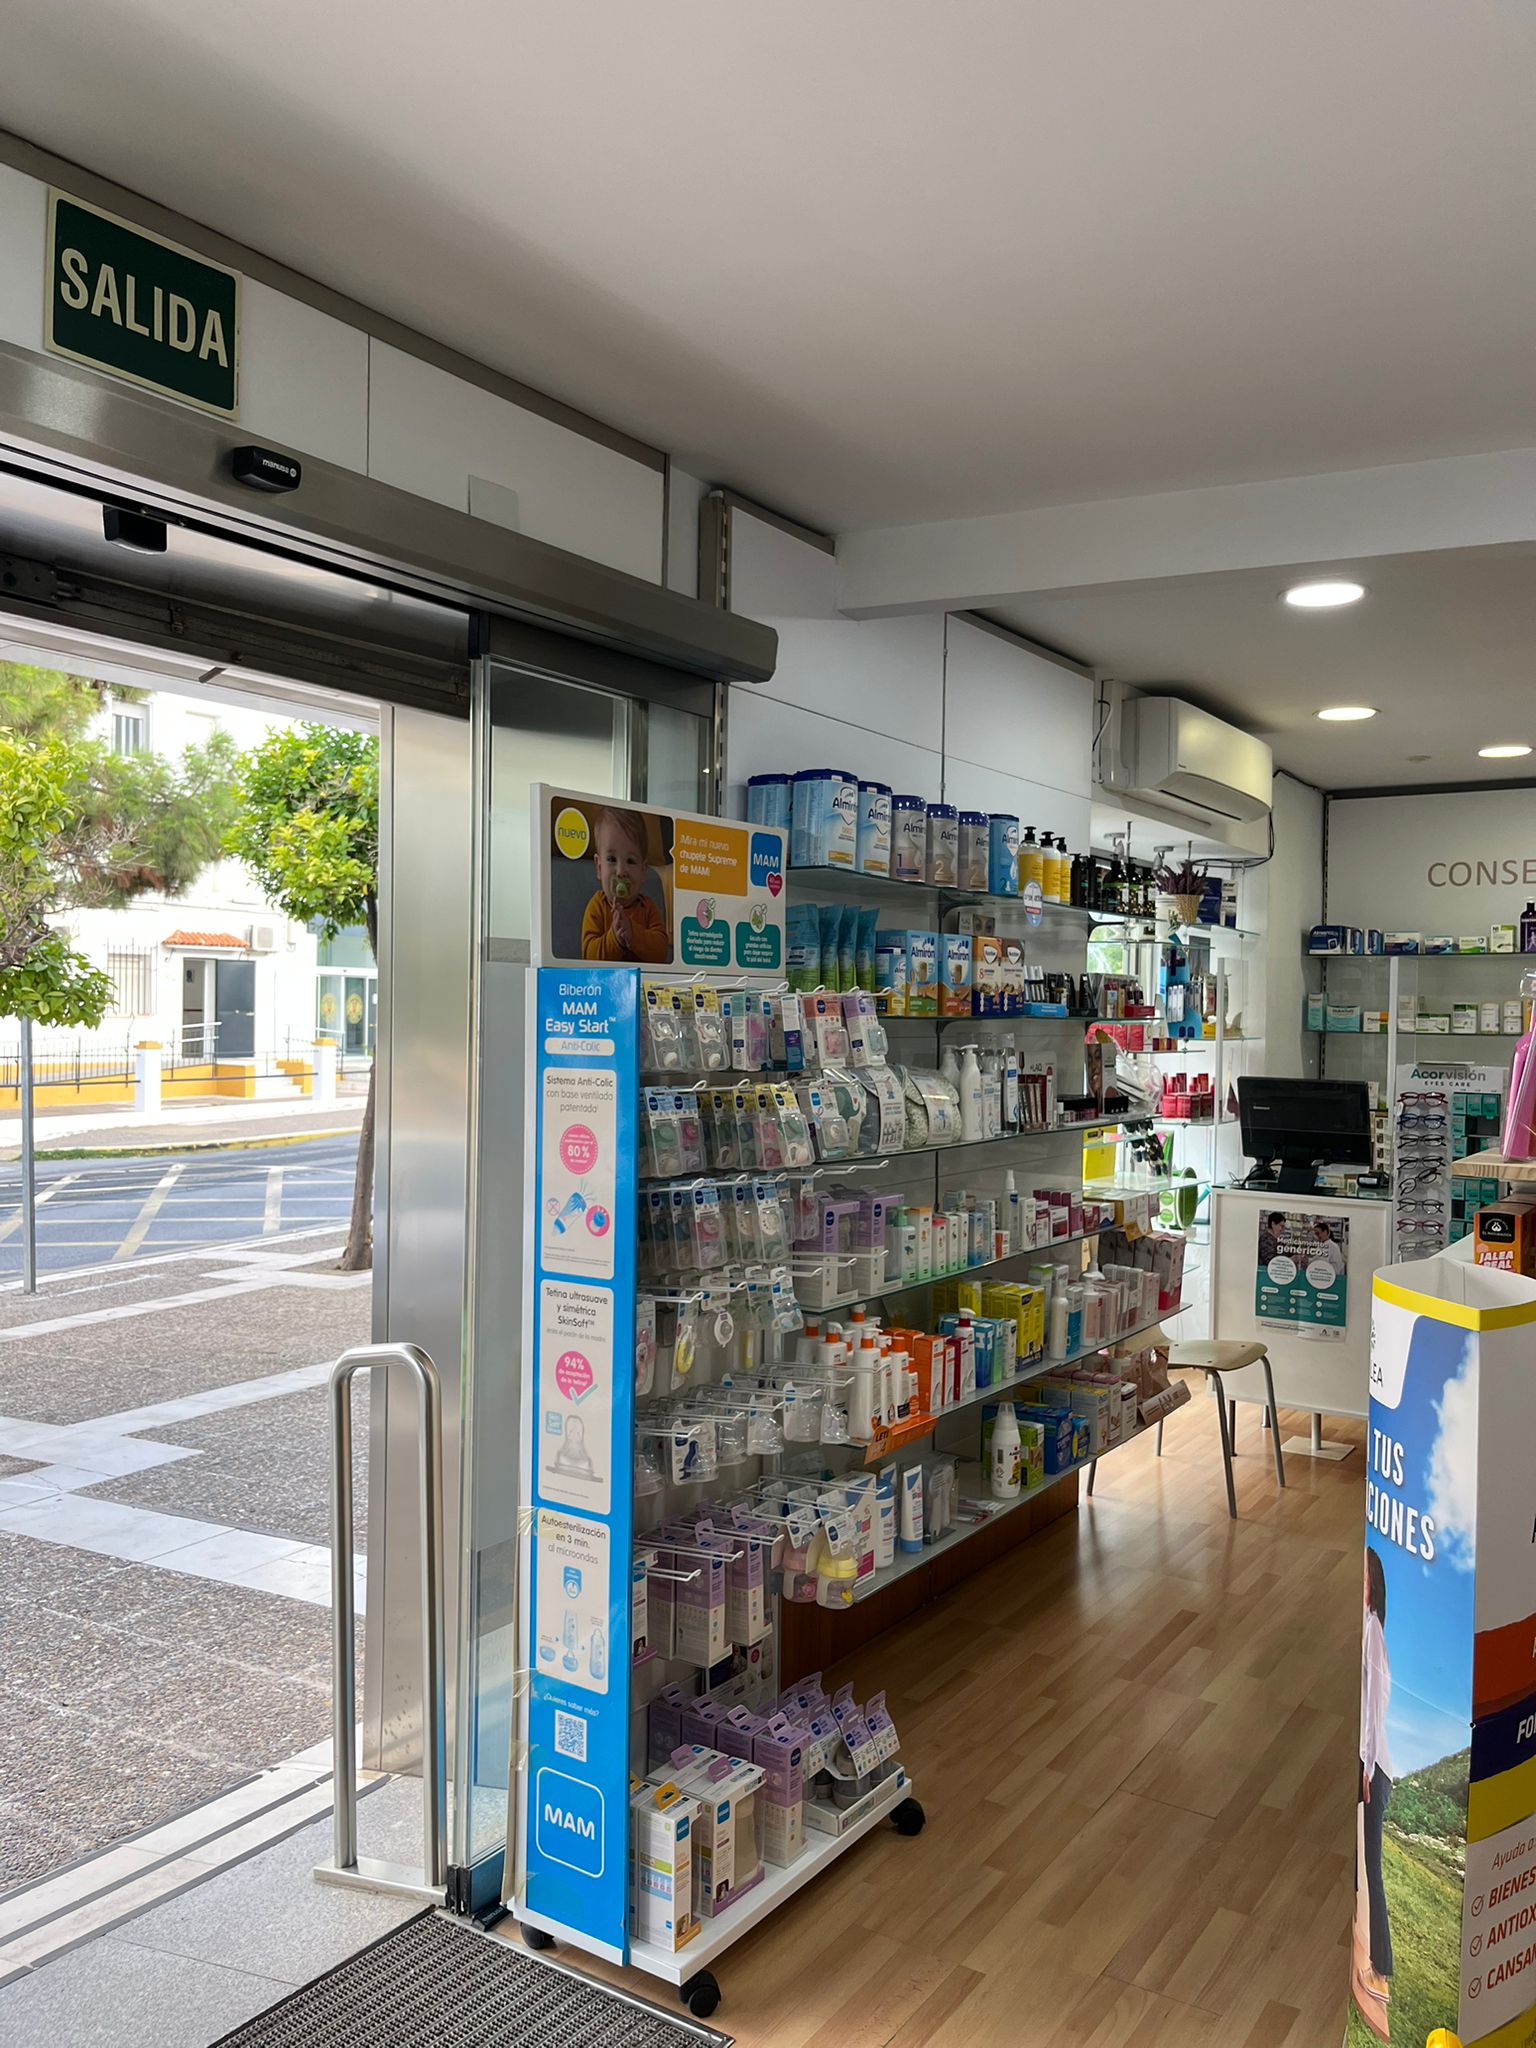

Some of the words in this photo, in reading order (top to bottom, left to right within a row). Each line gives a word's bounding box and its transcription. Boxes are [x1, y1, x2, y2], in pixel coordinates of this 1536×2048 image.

[61, 248, 229, 367] SALIDA
[558, 827, 587, 841] nuevo
[709, 841, 729, 851] nuevo
[680, 850, 706, 862] chupete
[708, 853, 737, 867] Supreme
[753, 853, 779, 868] MAM
[680, 864, 689, 873] de
[1427, 859, 1536, 888] CONSE
[559, 983, 602, 996] Biberón
[562, 1002, 598, 1016] MAM
[546, 1018, 575, 1035] Easy
[561, 1041, 600, 1052] Anti-Colic
[546, 1075, 576, 1086] Sistema
[577, 1076, 613, 1088] Anti-Colic
[1410, 1068, 1486, 1082] Acorvisión
[546, 1089, 560, 1098] con
[561, 1089, 579, 1099] base
[580, 1090, 613, 1101] ventilada
[1276, 1244, 1329, 1257] genéricos
[1479, 1250, 1514, 1264] JALEA
[546, 1287, 567, 1299] Tetina
[569, 1291, 608, 1304] ultrasuave
[557, 1304, 562, 1312] y
[563, 1304, 597, 1316] simétrica
[564, 1356, 585, 1371] 94%
[1370, 1363, 1384, 1388] EA
[1374, 1428, 1404, 1486] TUS
[541, 1515, 607, 1540] Autoesterilización
[1366, 1480, 1435, 1560] CIONES
[556, 1533, 566, 1542] en
[566, 1535, 573, 1544] 3
[574, 1537, 591, 1549] min.
[548, 1543, 555, 1552] al
[556, 1545, 599, 1565] microondas
[1516, 1712, 1536, 1744] FO
[544, 1803, 595, 1841] MAM
[1491, 1841, 1526, 1871] Ayuda
[1488, 1866, 1536, 1909] BIENES
[1486, 1903, 1536, 1949] ANTIOX
